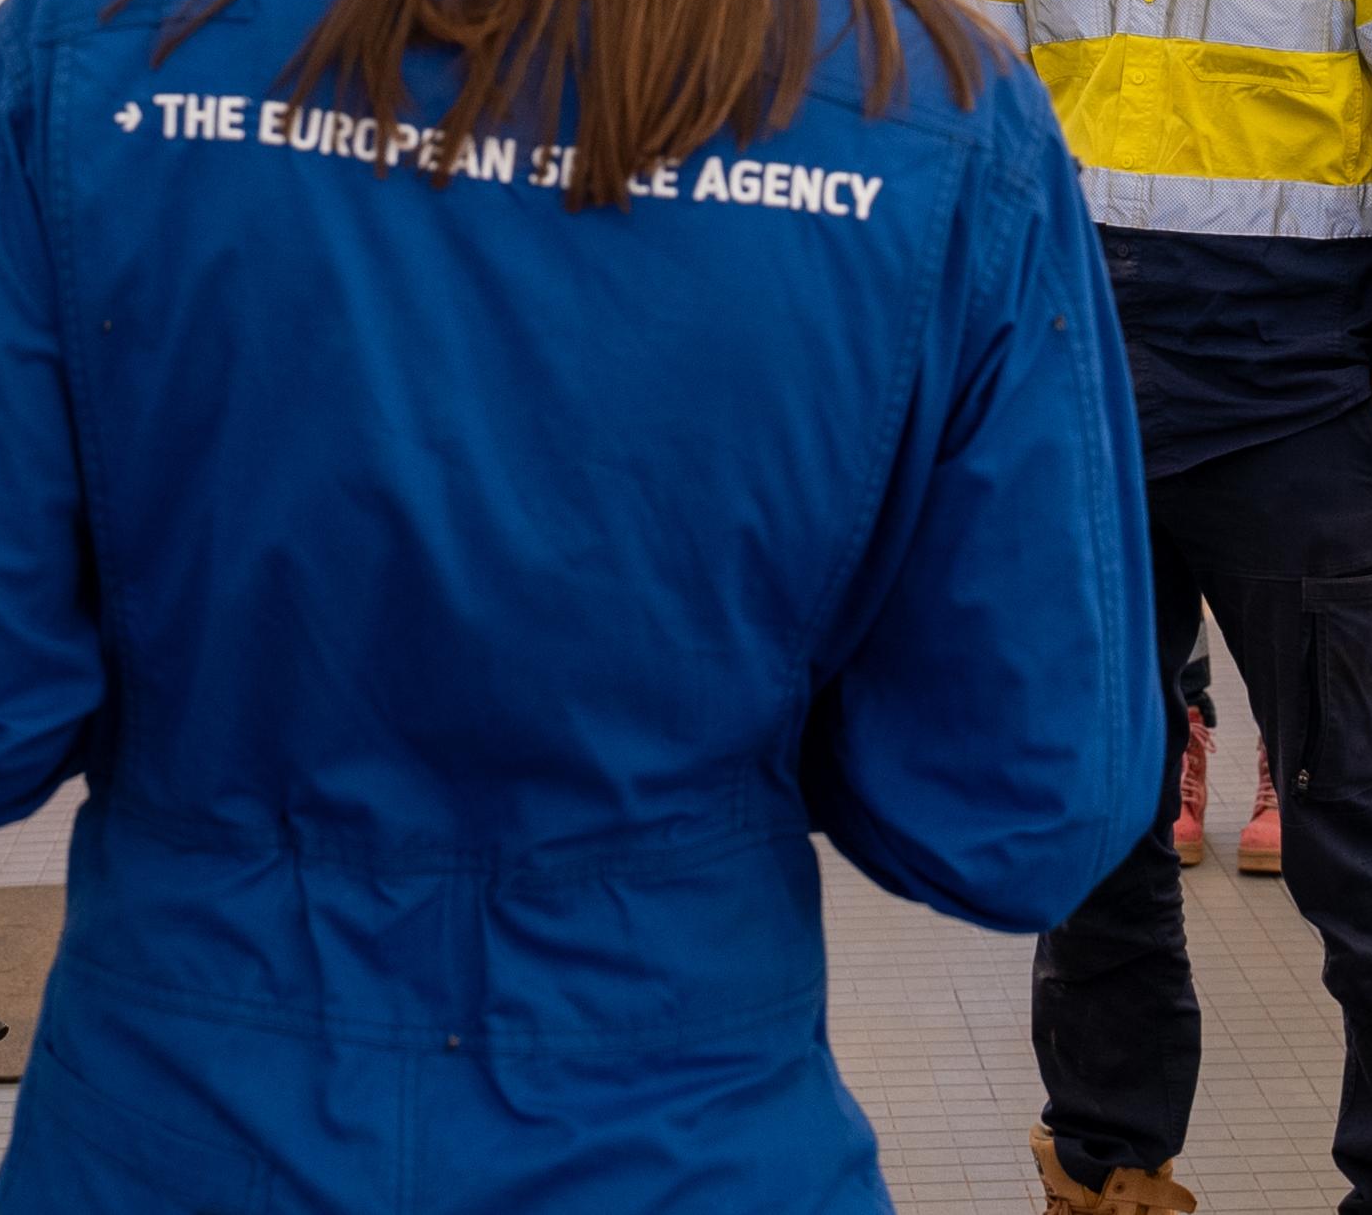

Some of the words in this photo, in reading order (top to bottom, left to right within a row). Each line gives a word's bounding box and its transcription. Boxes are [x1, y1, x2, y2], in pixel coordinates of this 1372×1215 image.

[152, 93, 251, 141] THE
[258, 100, 517, 185] EUROPEAN
[691, 154, 884, 222] AGENCY
